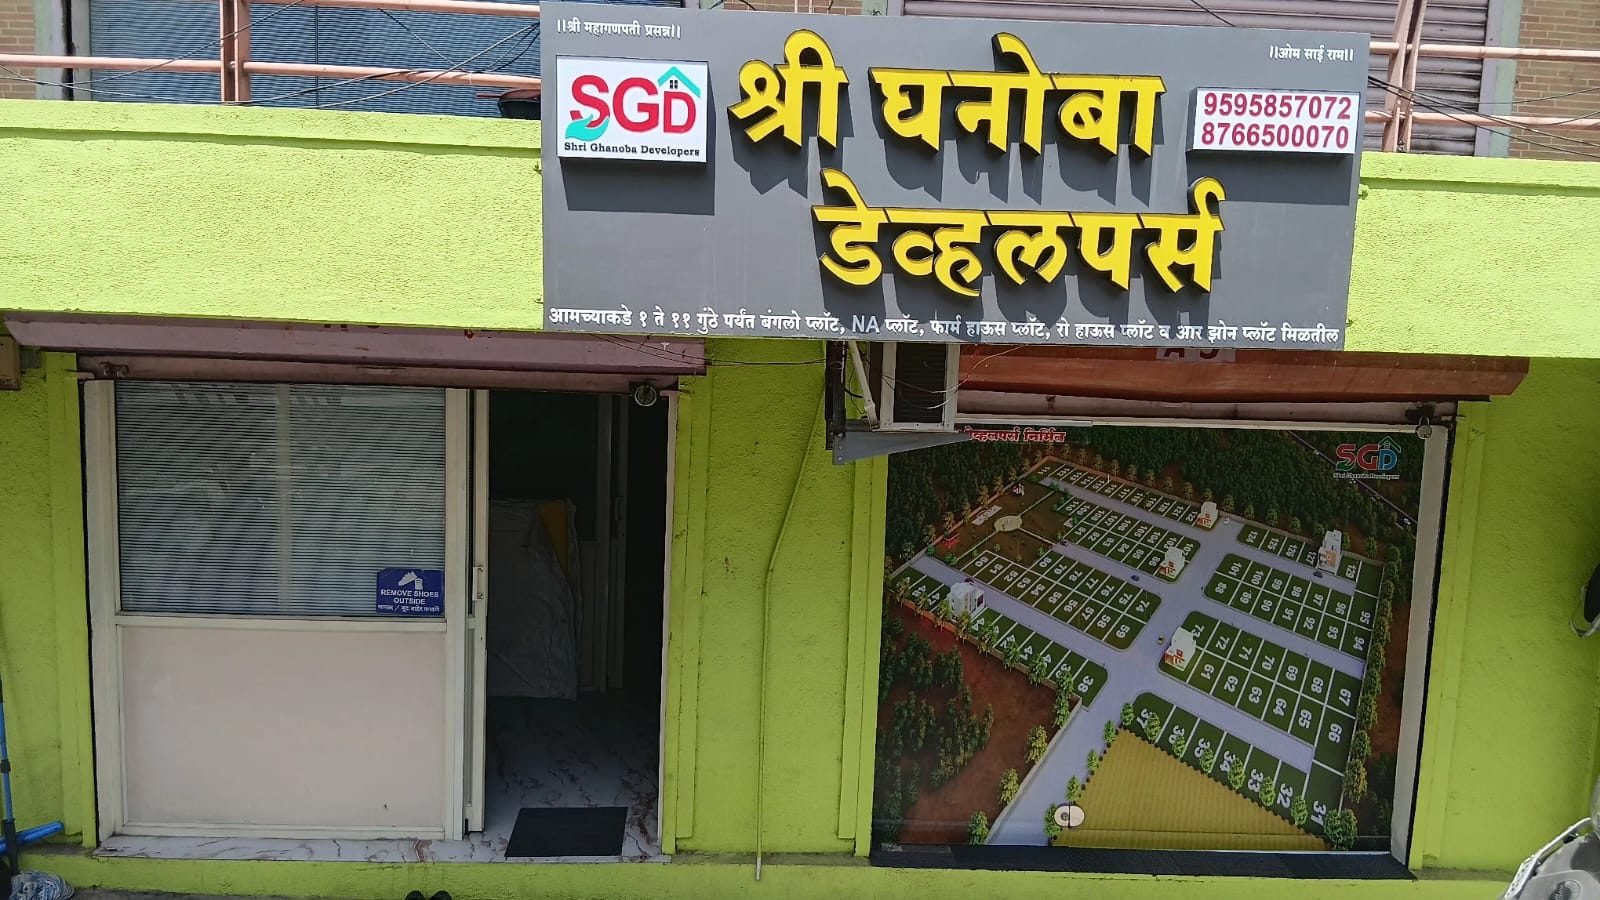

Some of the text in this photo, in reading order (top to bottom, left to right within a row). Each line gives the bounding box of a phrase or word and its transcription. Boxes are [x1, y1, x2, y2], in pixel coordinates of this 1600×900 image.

[583, 20, 641, 37] महागणपती
[1303, 44, 1324, 63] साई
[727, 29, 1167, 156] श्री घनोबा
[570, 75, 697, 134] SGD
[1204, 92, 1352, 120] 9595857072
[1201, 122, 1349, 149] 8766500070
[564, 141, 700, 157] Shri Ghanoba Developers
[811, 167, 1226, 297] डेव्हलपर्स
[548, 304, 633, 326] आमच्याकडे
[639, 311, 649, 329] १
[653, 305, 665, 327] ते
[671, 311, 691, 329] ११
[697, 307, 718, 334] गुंठे
[759, 309, 802, 331] बंगलो
[805, 312, 846, 336] प्लॉट,
[851, 314, 880, 333] NA
[885, 314, 925, 337] प्लॉट,
[929, 314, 962, 336] फार्म
[966, 320, 1006, 337] हाऊस
[1010, 317, 1051, 340] प्लॉट,
[1056, 317, 1070, 339] रो
[1074, 323, 1115, 339] हाऊस
[1120, 319, 1155, 340] प्लॉट
[1158, 325, 1170, 341] व
[1175, 325, 1203, 341] आर
[1207, 320, 1239, 344] झोन
[1242, 321, 1276, 342] प्लॉट
[1281, 322, 1340, 344] मिळतील
[1336, 443, 1398, 471] SGD
[1074, 526, 1086, 536] 81
[1088, 532, 1100, 541] 82
[1103, 538, 1114, 547] 83
[1118, 544, 1130, 554] 84
[974, 556, 988, 567] 50
[1039, 557, 1052, 567] 80
[1132, 550, 1144, 560] 85
[1149, 556, 1161, 566] 86
[989, 564, 1003, 574] 51
[1054, 564, 1068, 575] 79
[1004, 571, 1018, 583] 52
[1017, 577, 1031, 589] 53
[1069, 571, 1083, 582] 78
[1086, 577, 1099, 589] 77
[1031, 584, 1046, 596] 54
[1100, 585, 1115, 596] 76
[1215, 582, 1227, 594] 88
[1272, 578, 1283, 590] 99
[380, 589, 439, 598] REMOVE SHOES
[1048, 592, 1062, 604] 55
[1118, 593, 1132, 605] 75
[1239, 591, 1252, 604] 89
[1291, 586, 1302, 598] 98
[393, 597, 426, 605] OUTSIDE
[1064, 600, 1078, 612] 56
[1136, 600, 1150, 612] 74
[1261, 599, 1273, 612] 90
[1313, 593, 1324, 607] 97
[1081, 607, 1094, 620] 57
[1282, 608, 1294, 622] 91
[1336, 602, 1347, 615] 96
[972, 618, 985, 631] 44
[1097, 614, 1111, 628] 58
[1303, 616, 1316, 630] 92
[1360, 611, 1371, 625] 95
[1116, 625, 1130, 638] 59
[1327, 626, 1339, 640] 93
[1216, 635, 1230, 650] 72
[1353, 636, 1365, 651] 94
[1238, 645, 1252, 660] 71
[1261, 655, 1275, 671] 70
[1201, 664, 1215, 680] 61
[1285, 665, 1299, 682] 69
[1078, 676, 1094, 692] 38
[1224, 675, 1238, 692] 62
[1311, 676, 1324, 694] 68
[1248, 686, 1263, 704] 63
[1339, 688, 1351, 707] 67
[1273, 698, 1288, 716] 64
[1298, 709, 1312, 729] 65
[1328, 723, 1342, 744] 66
[1247, 768, 1264, 793] 33
[1277, 783, 1293, 808] 32
[1310, 801, 1327, 826] 31
